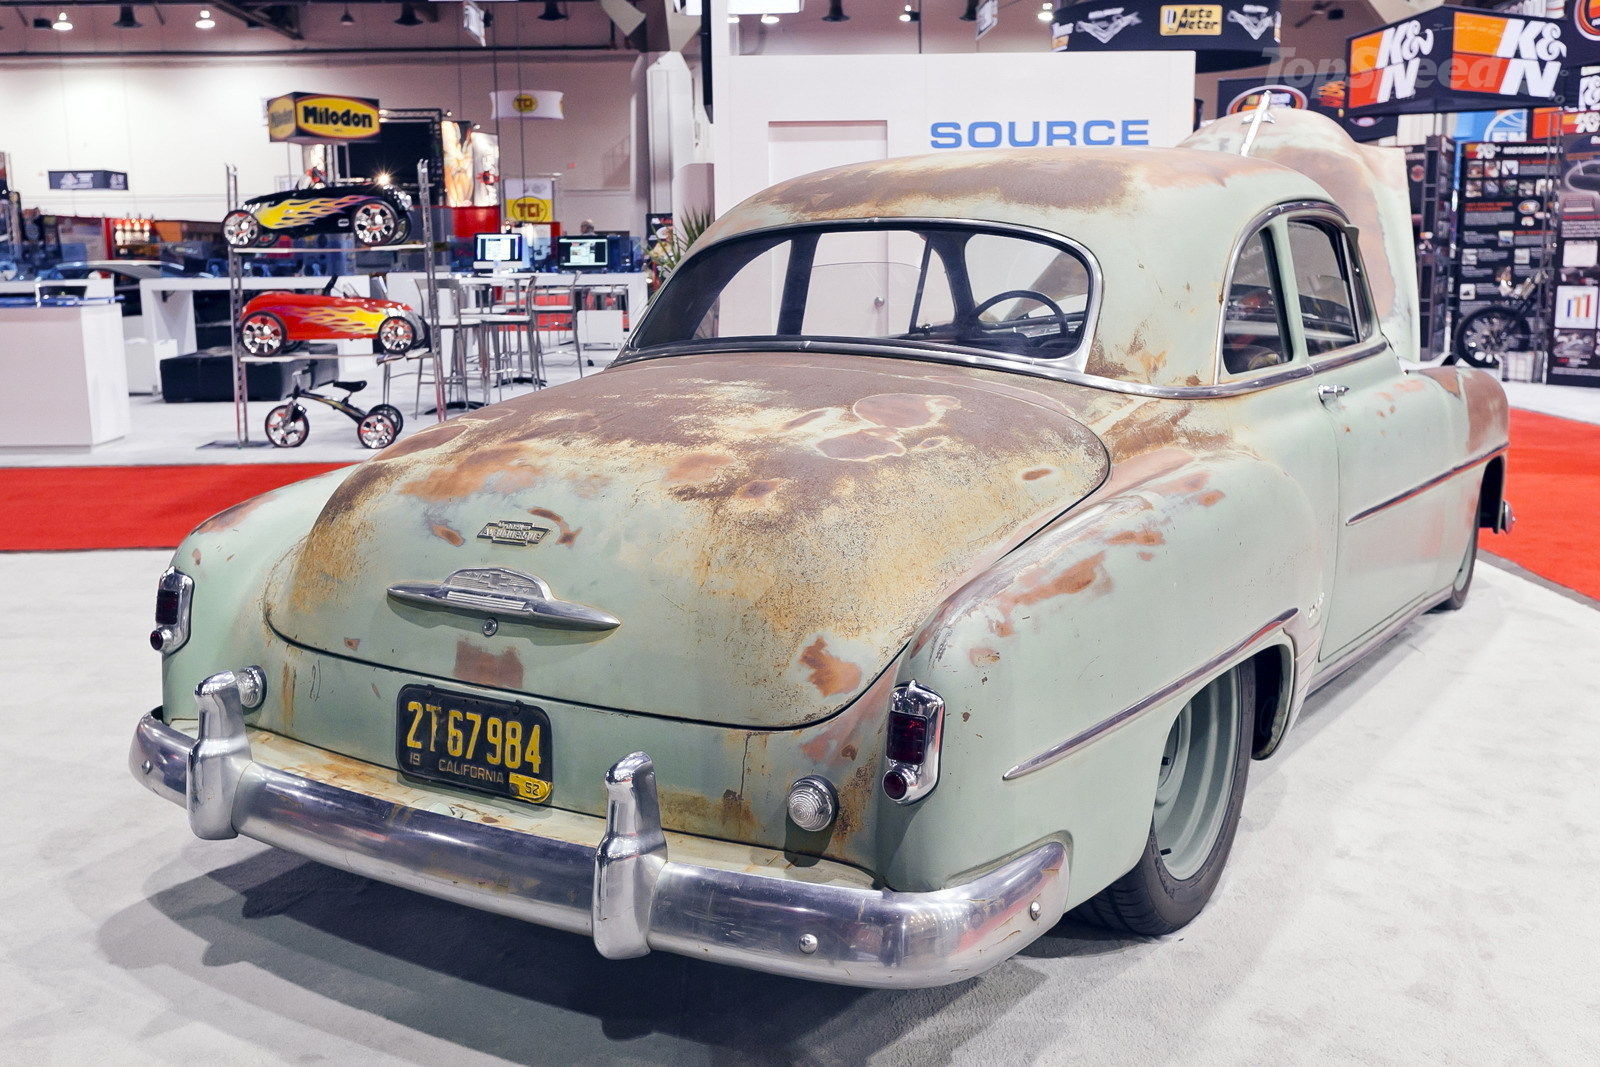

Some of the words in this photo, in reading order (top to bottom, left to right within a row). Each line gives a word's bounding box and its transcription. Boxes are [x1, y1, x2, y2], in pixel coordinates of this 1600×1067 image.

[1181, 8, 1213, 19] Auto
[1179, 20, 1218, 30] Meter
[303, 106, 372, 128] Milodon
[930, 119, 1149, 149] SOURCE
[438, 758, 504, 784] CALIFORNIA
[525, 781, 540, 796] 52
